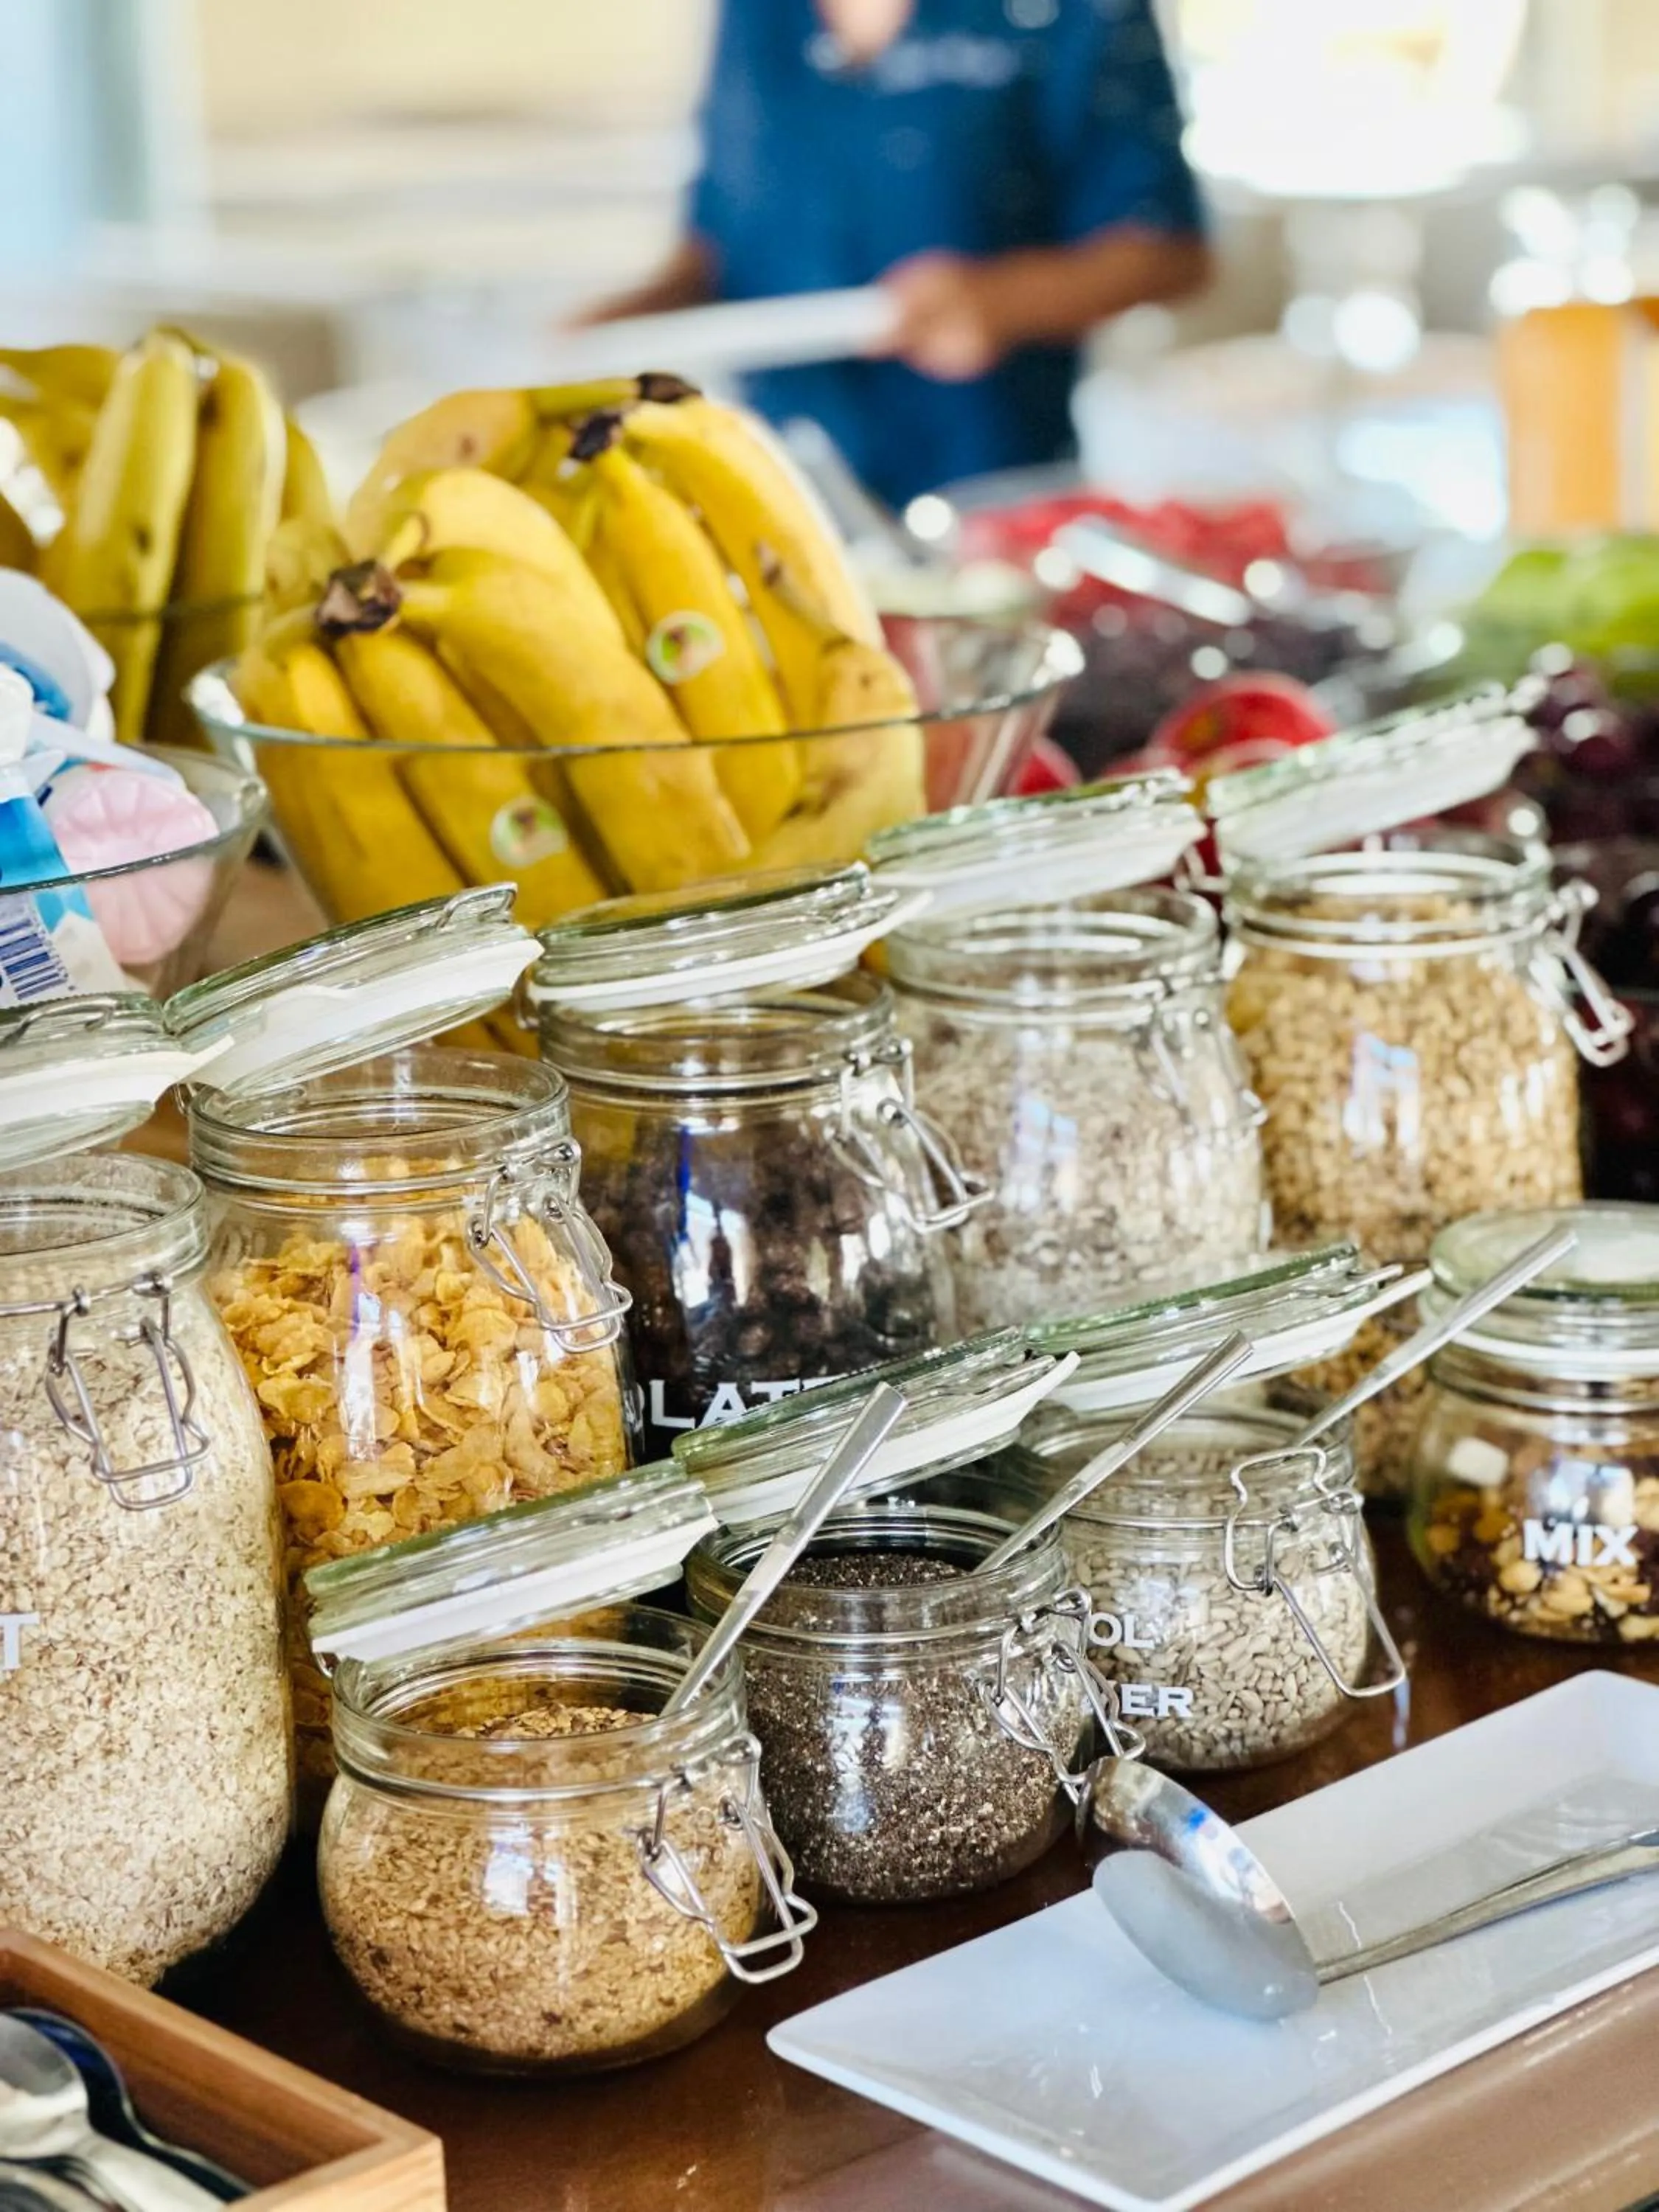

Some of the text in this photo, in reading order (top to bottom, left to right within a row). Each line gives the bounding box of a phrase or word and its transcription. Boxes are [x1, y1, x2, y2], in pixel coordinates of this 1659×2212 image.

[636, 1373, 847, 1432] LAT
[1523, 1518, 1638, 1567] MIX
[1106, 1680, 1193, 1717] ER
